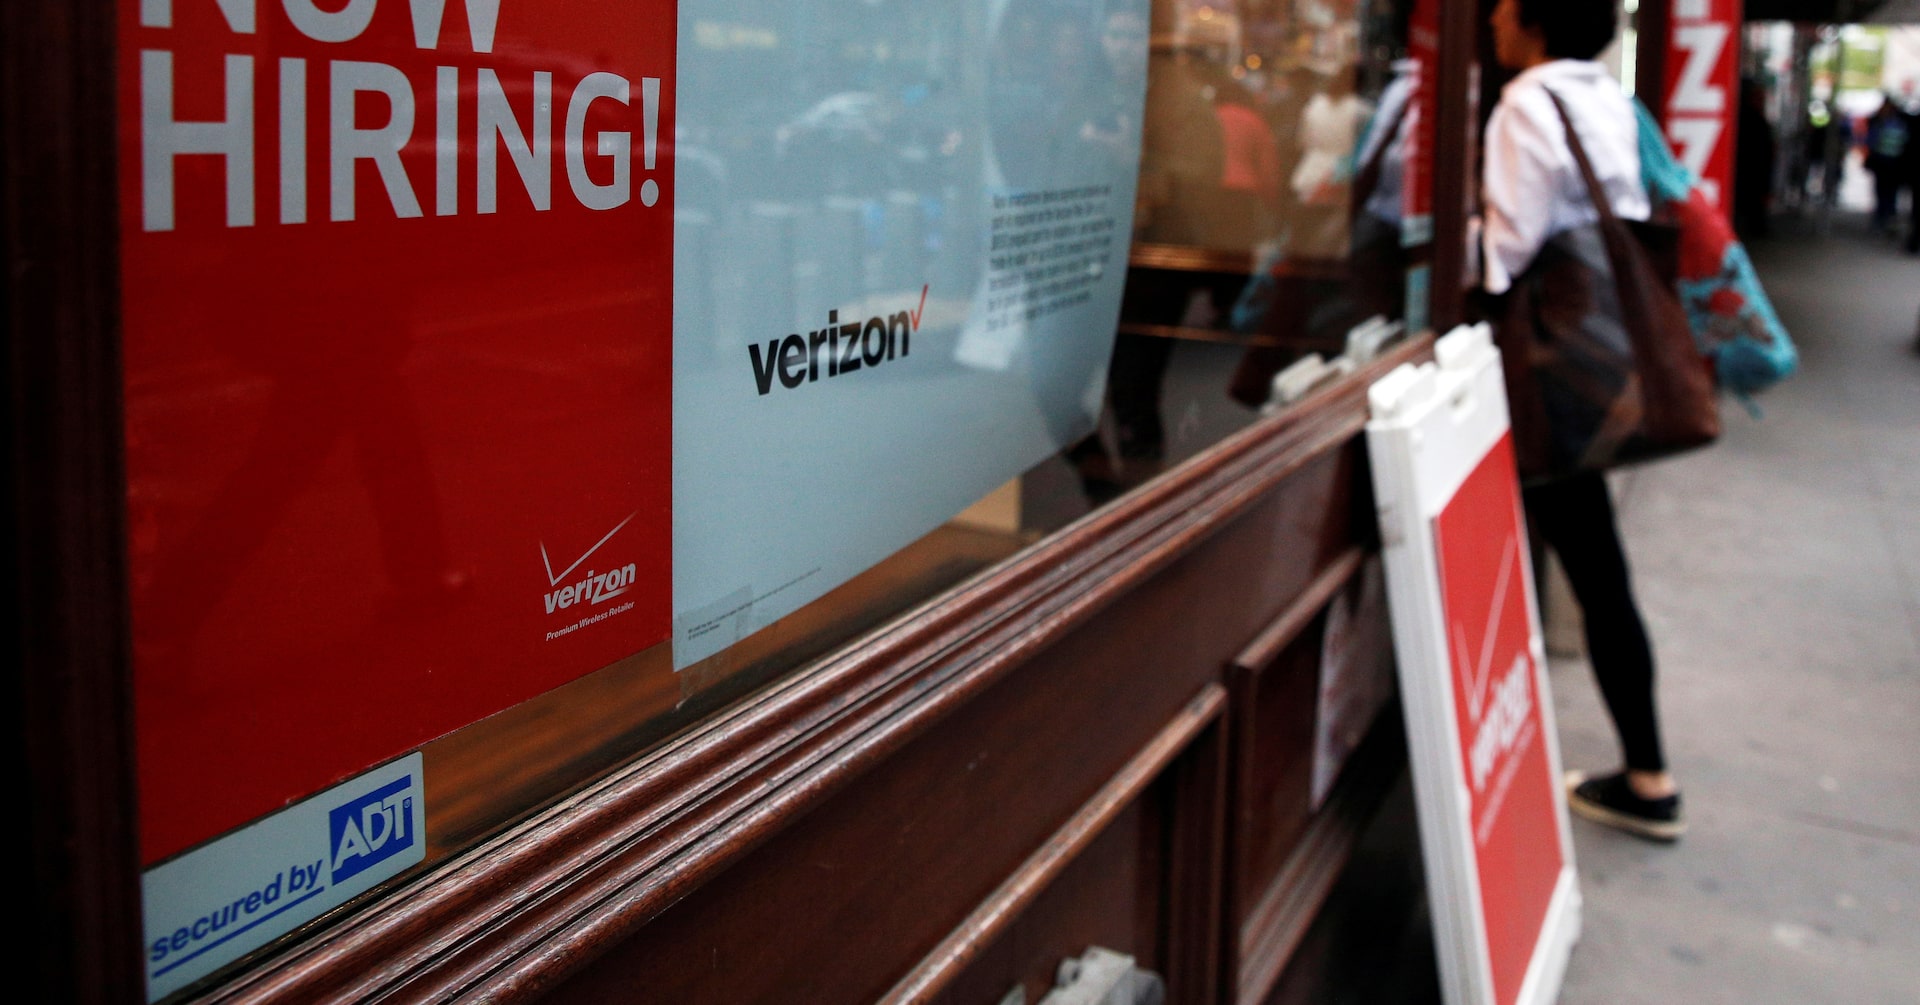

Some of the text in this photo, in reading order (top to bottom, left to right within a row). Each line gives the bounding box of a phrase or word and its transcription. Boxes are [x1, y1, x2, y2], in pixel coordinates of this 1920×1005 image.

[139, 49, 661, 231] HIRING!
[748, 309, 909, 395] verizon
[544, 562, 636, 614] verizon
[546, 601, 635, 641] Premium Wireless Retailer
[152, 786, 412, 961] secured by ADT
